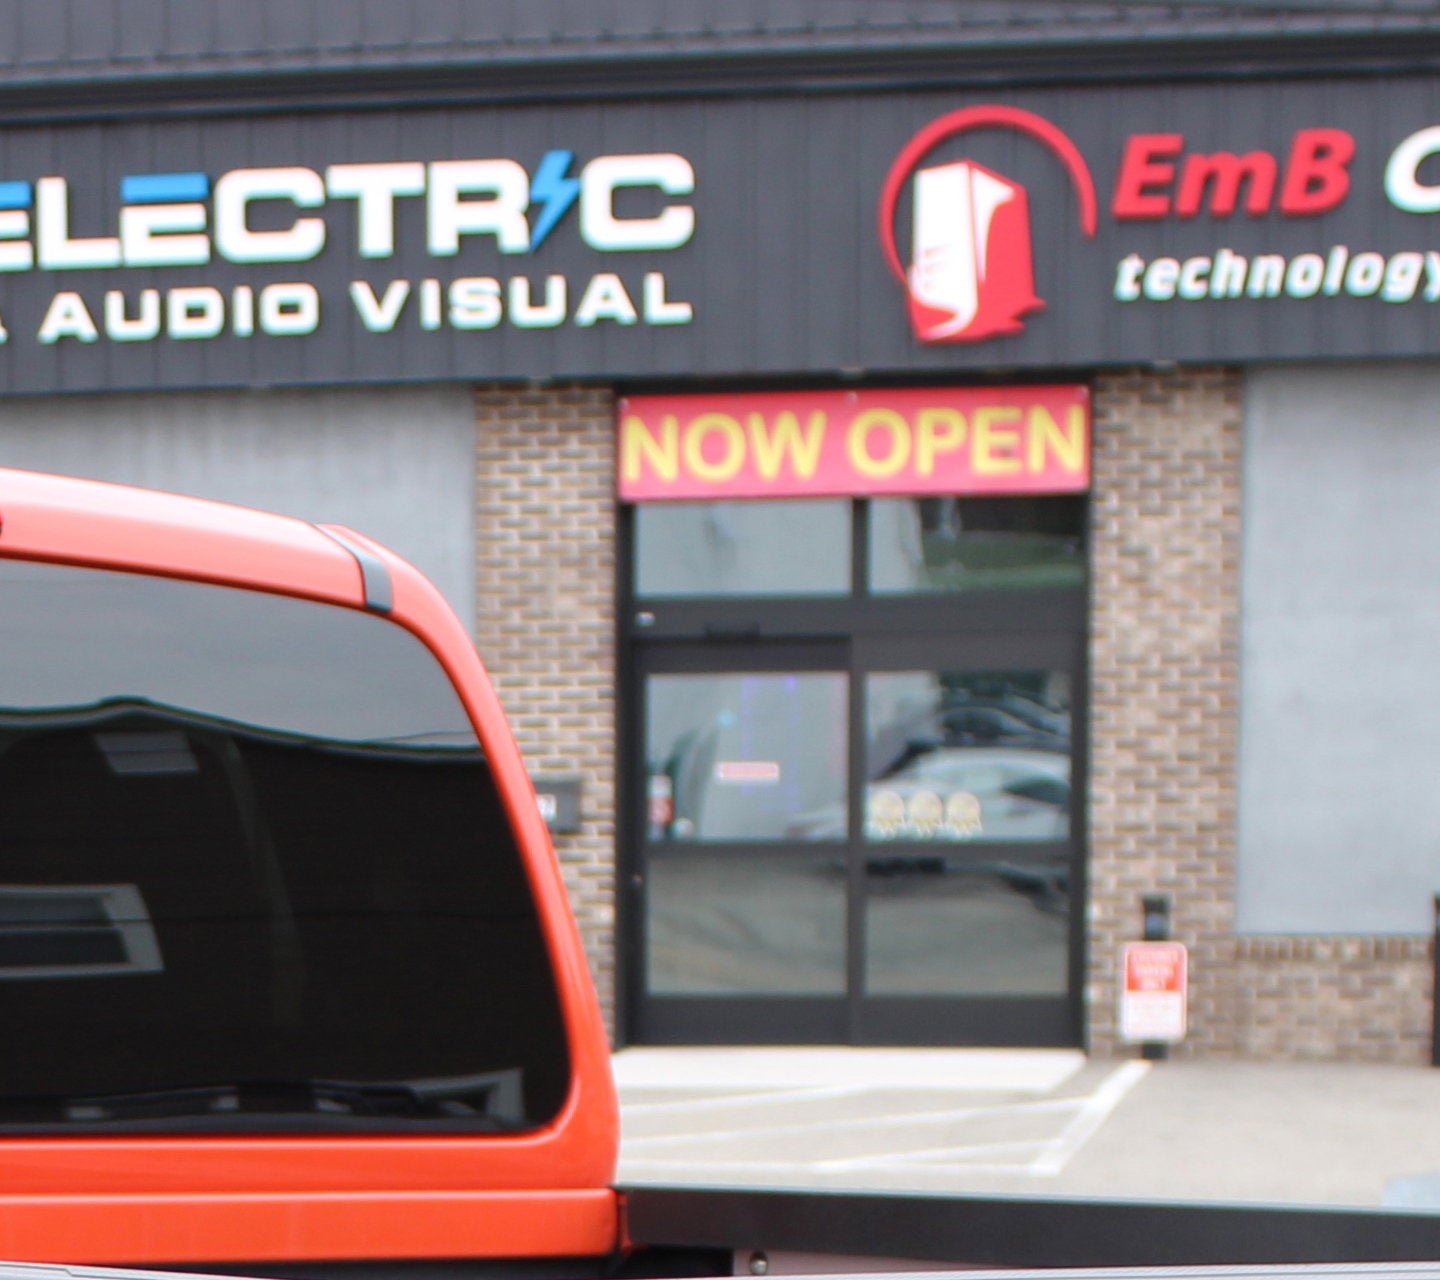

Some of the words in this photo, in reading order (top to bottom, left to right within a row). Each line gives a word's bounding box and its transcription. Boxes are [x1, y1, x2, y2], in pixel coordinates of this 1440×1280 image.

[1112, 127, 1353, 219] EmB
[39, 281, 320, 342] AUDIO
[350, 273, 693, 332] VISUAL
[623, 411, 825, 481] NOW
[848, 405, 1084, 477] OPEN
